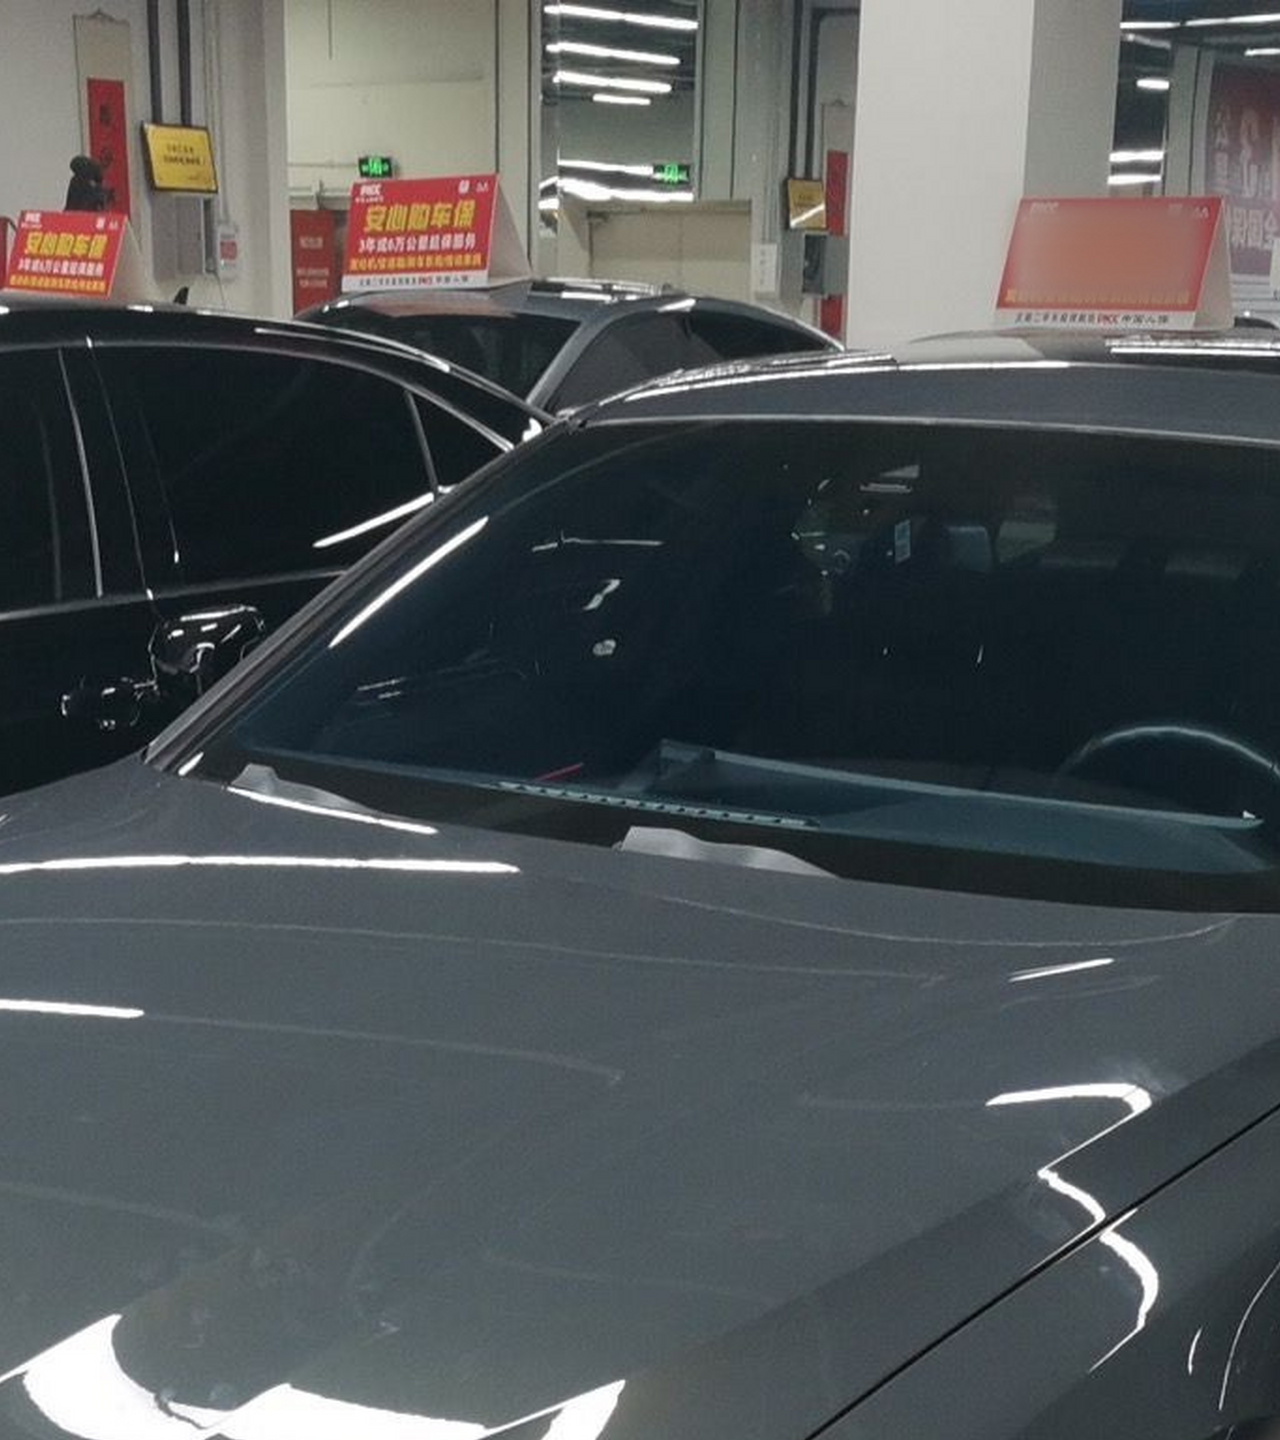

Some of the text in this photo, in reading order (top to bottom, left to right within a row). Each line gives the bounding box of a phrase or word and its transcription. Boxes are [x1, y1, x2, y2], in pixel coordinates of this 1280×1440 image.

[364, 199, 476, 233] 安心购车保
